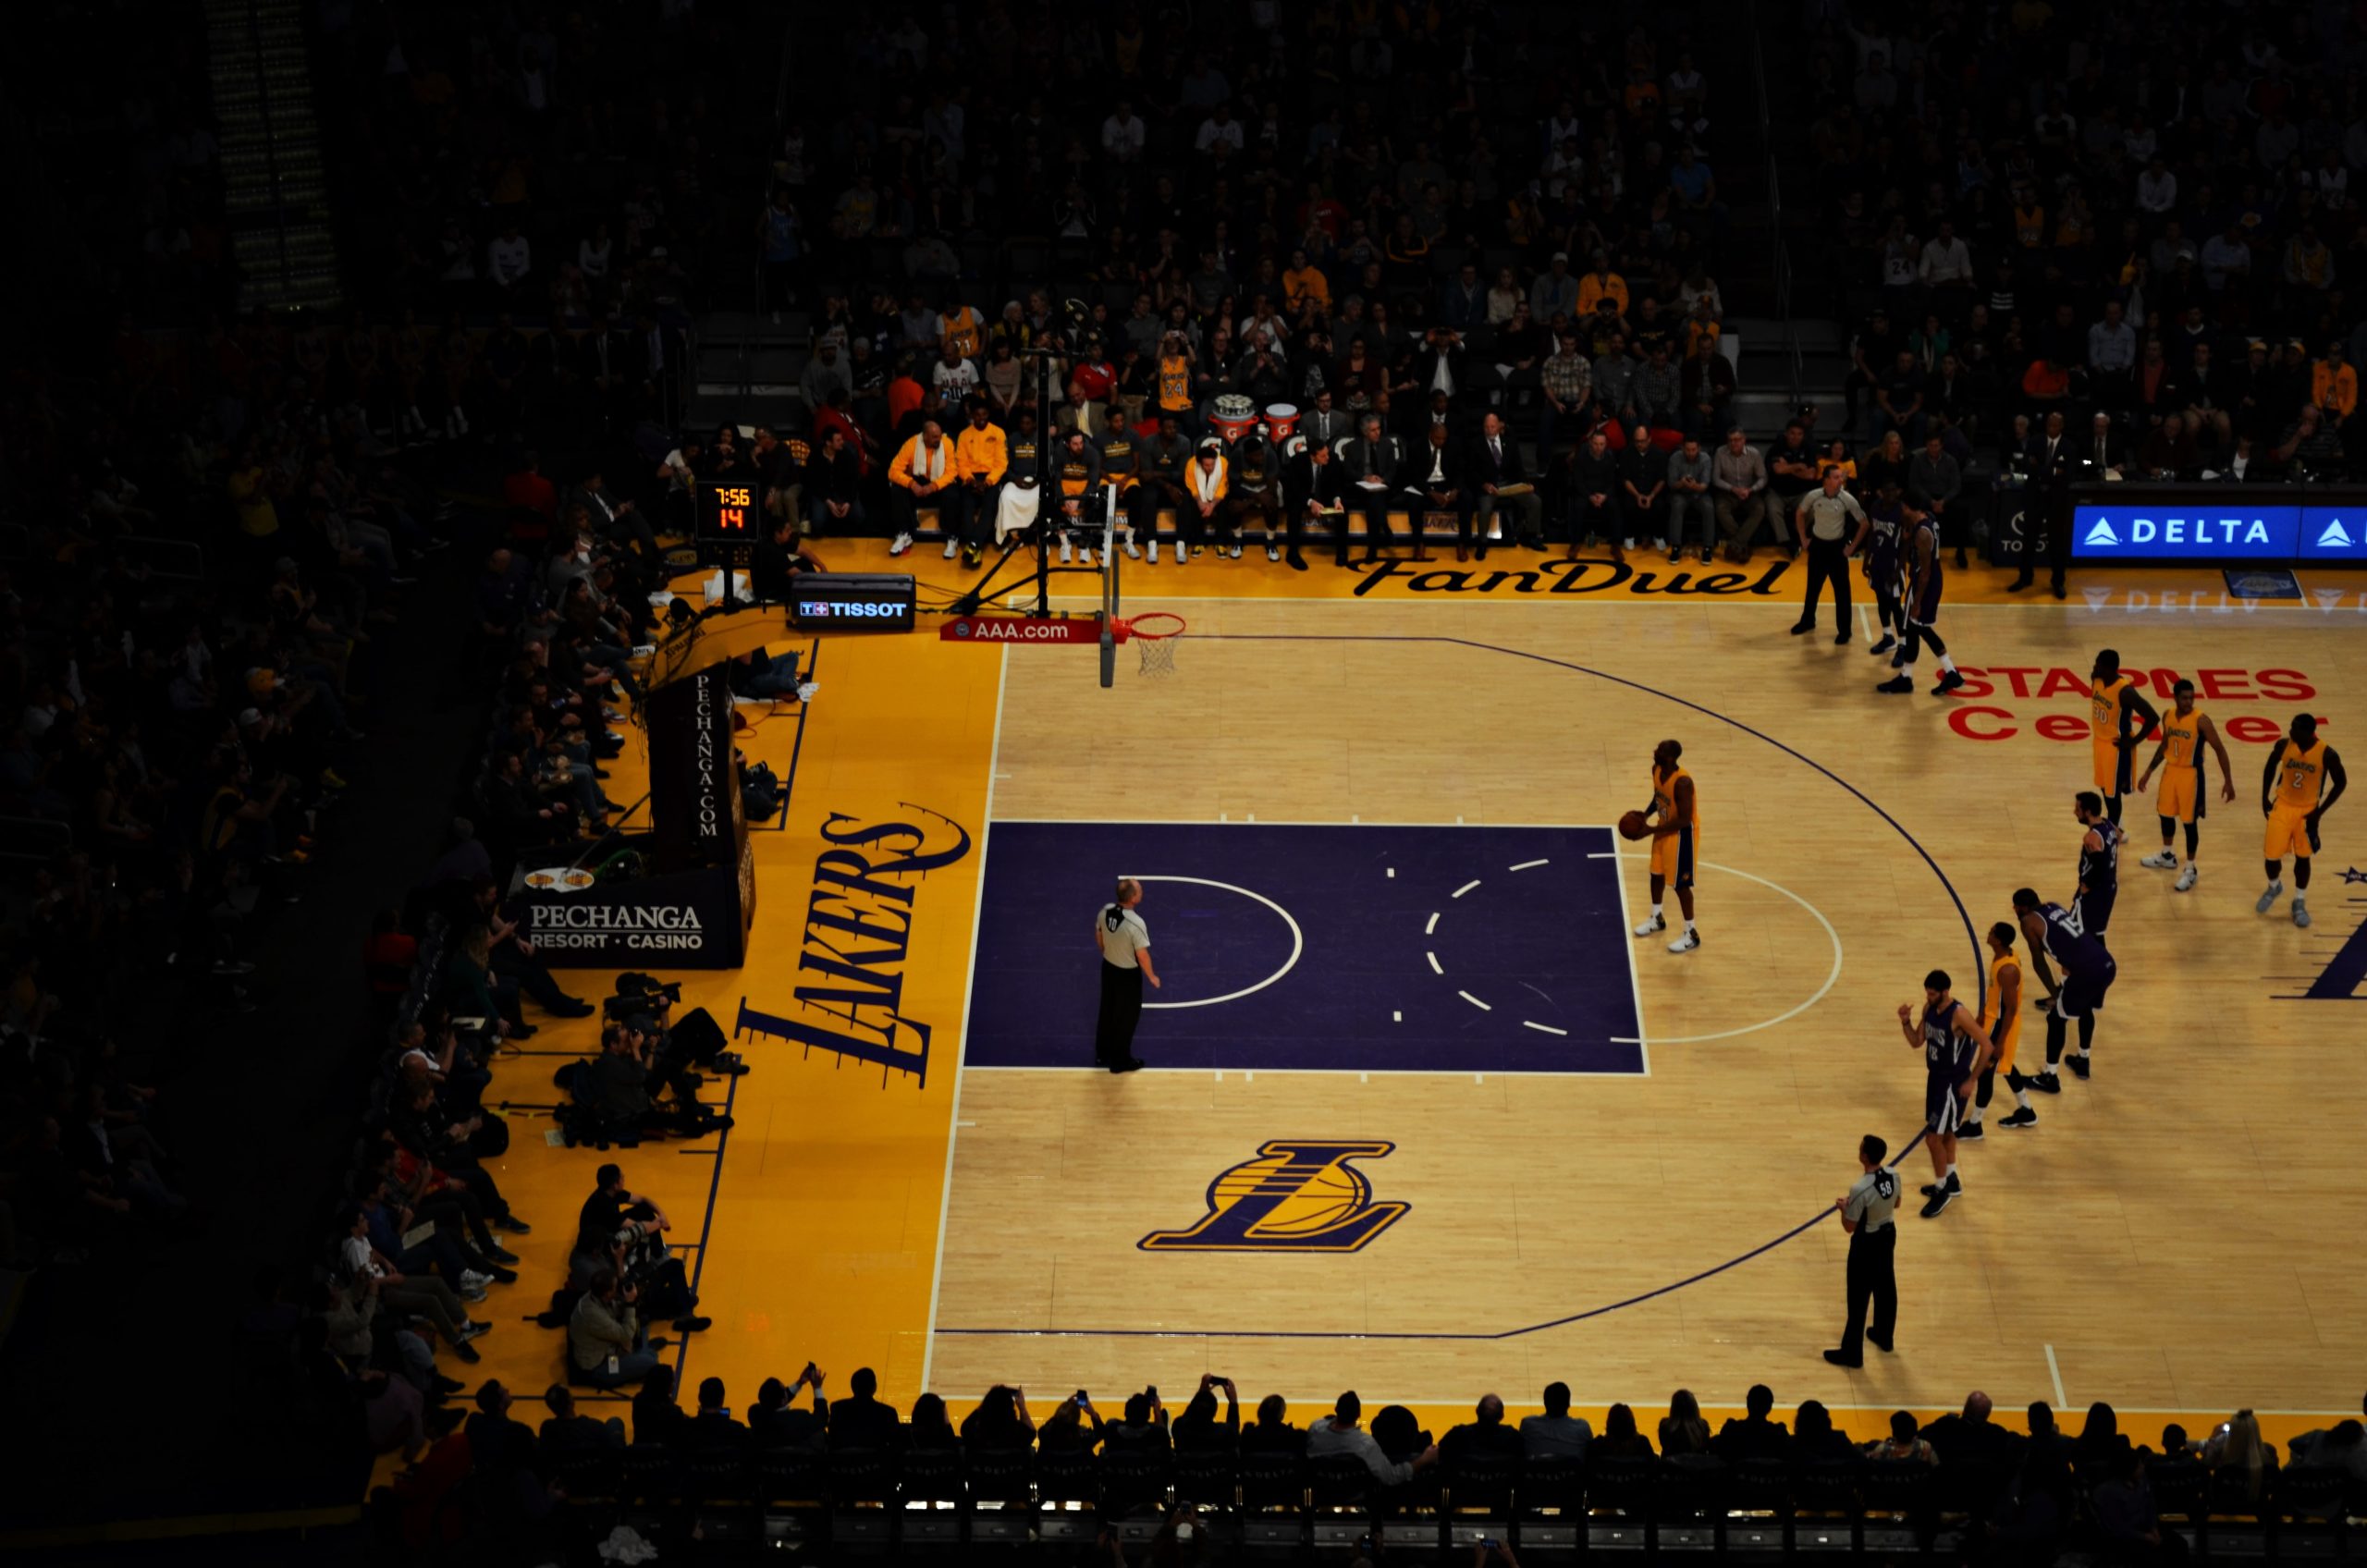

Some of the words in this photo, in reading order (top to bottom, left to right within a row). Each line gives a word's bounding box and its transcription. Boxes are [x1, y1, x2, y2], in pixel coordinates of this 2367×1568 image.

[1164, 382, 1184, 398] 24
[715, 488, 750, 507] 7:56
[719, 509, 743, 529] 14
[2132, 519, 2270, 544] DELTA
[1346, 557, 1790, 596] FanDuel
[830, 603, 907, 617] TISSOT
[975, 622, 1069, 639] AAA.com
[1948, 706, 2329, 743] Cee
[2293, 772, 2304, 788] 2
[530, 905, 703, 930] PECHANGA
[530, 934, 608, 949] RESORT
[626, 933, 703, 950] CASINO
[734, 801, 972, 1091] LAKERS
[1879, 1180, 1893, 1197] 58
